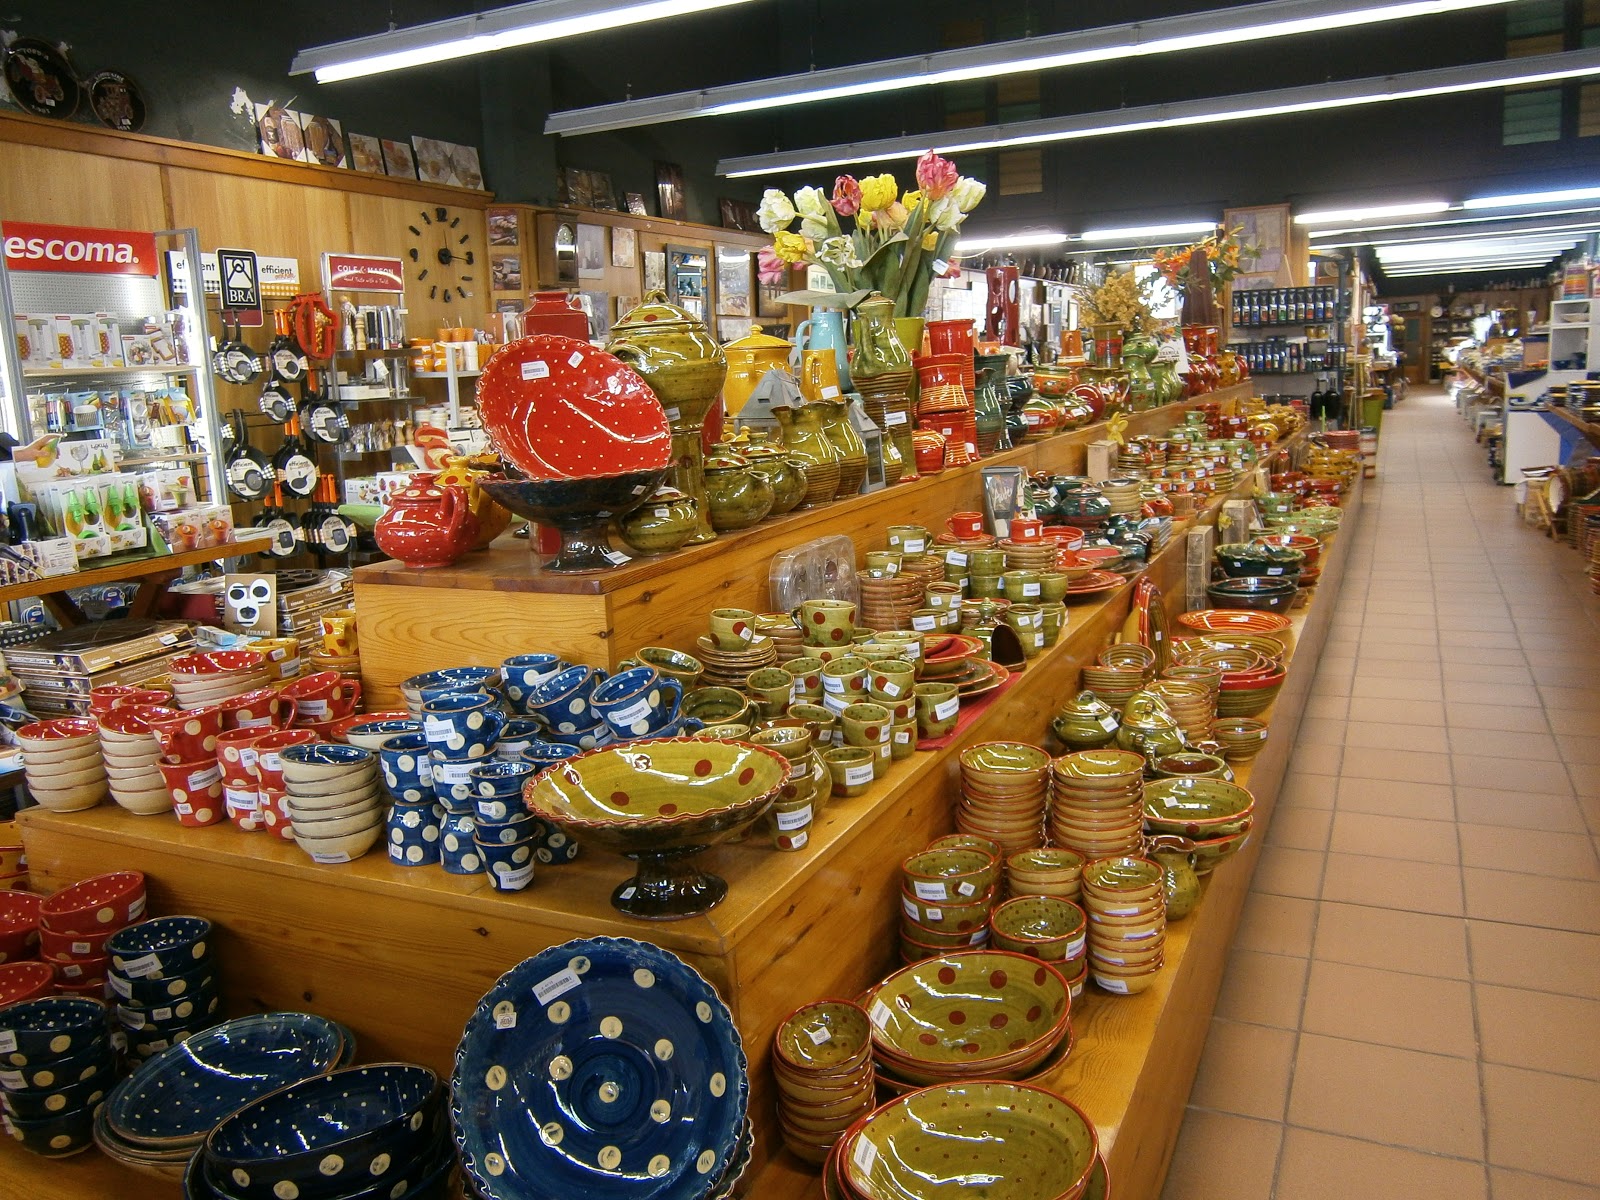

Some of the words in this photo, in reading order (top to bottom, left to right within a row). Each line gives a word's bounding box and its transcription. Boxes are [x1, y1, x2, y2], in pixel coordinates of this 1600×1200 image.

[4, 236, 139, 264] escoma.
[176, 259, 215, 271] efent
[261, 264, 293, 275] efficient
[337, 264, 358, 273] COLE
[230, 289, 254, 302] BRA
